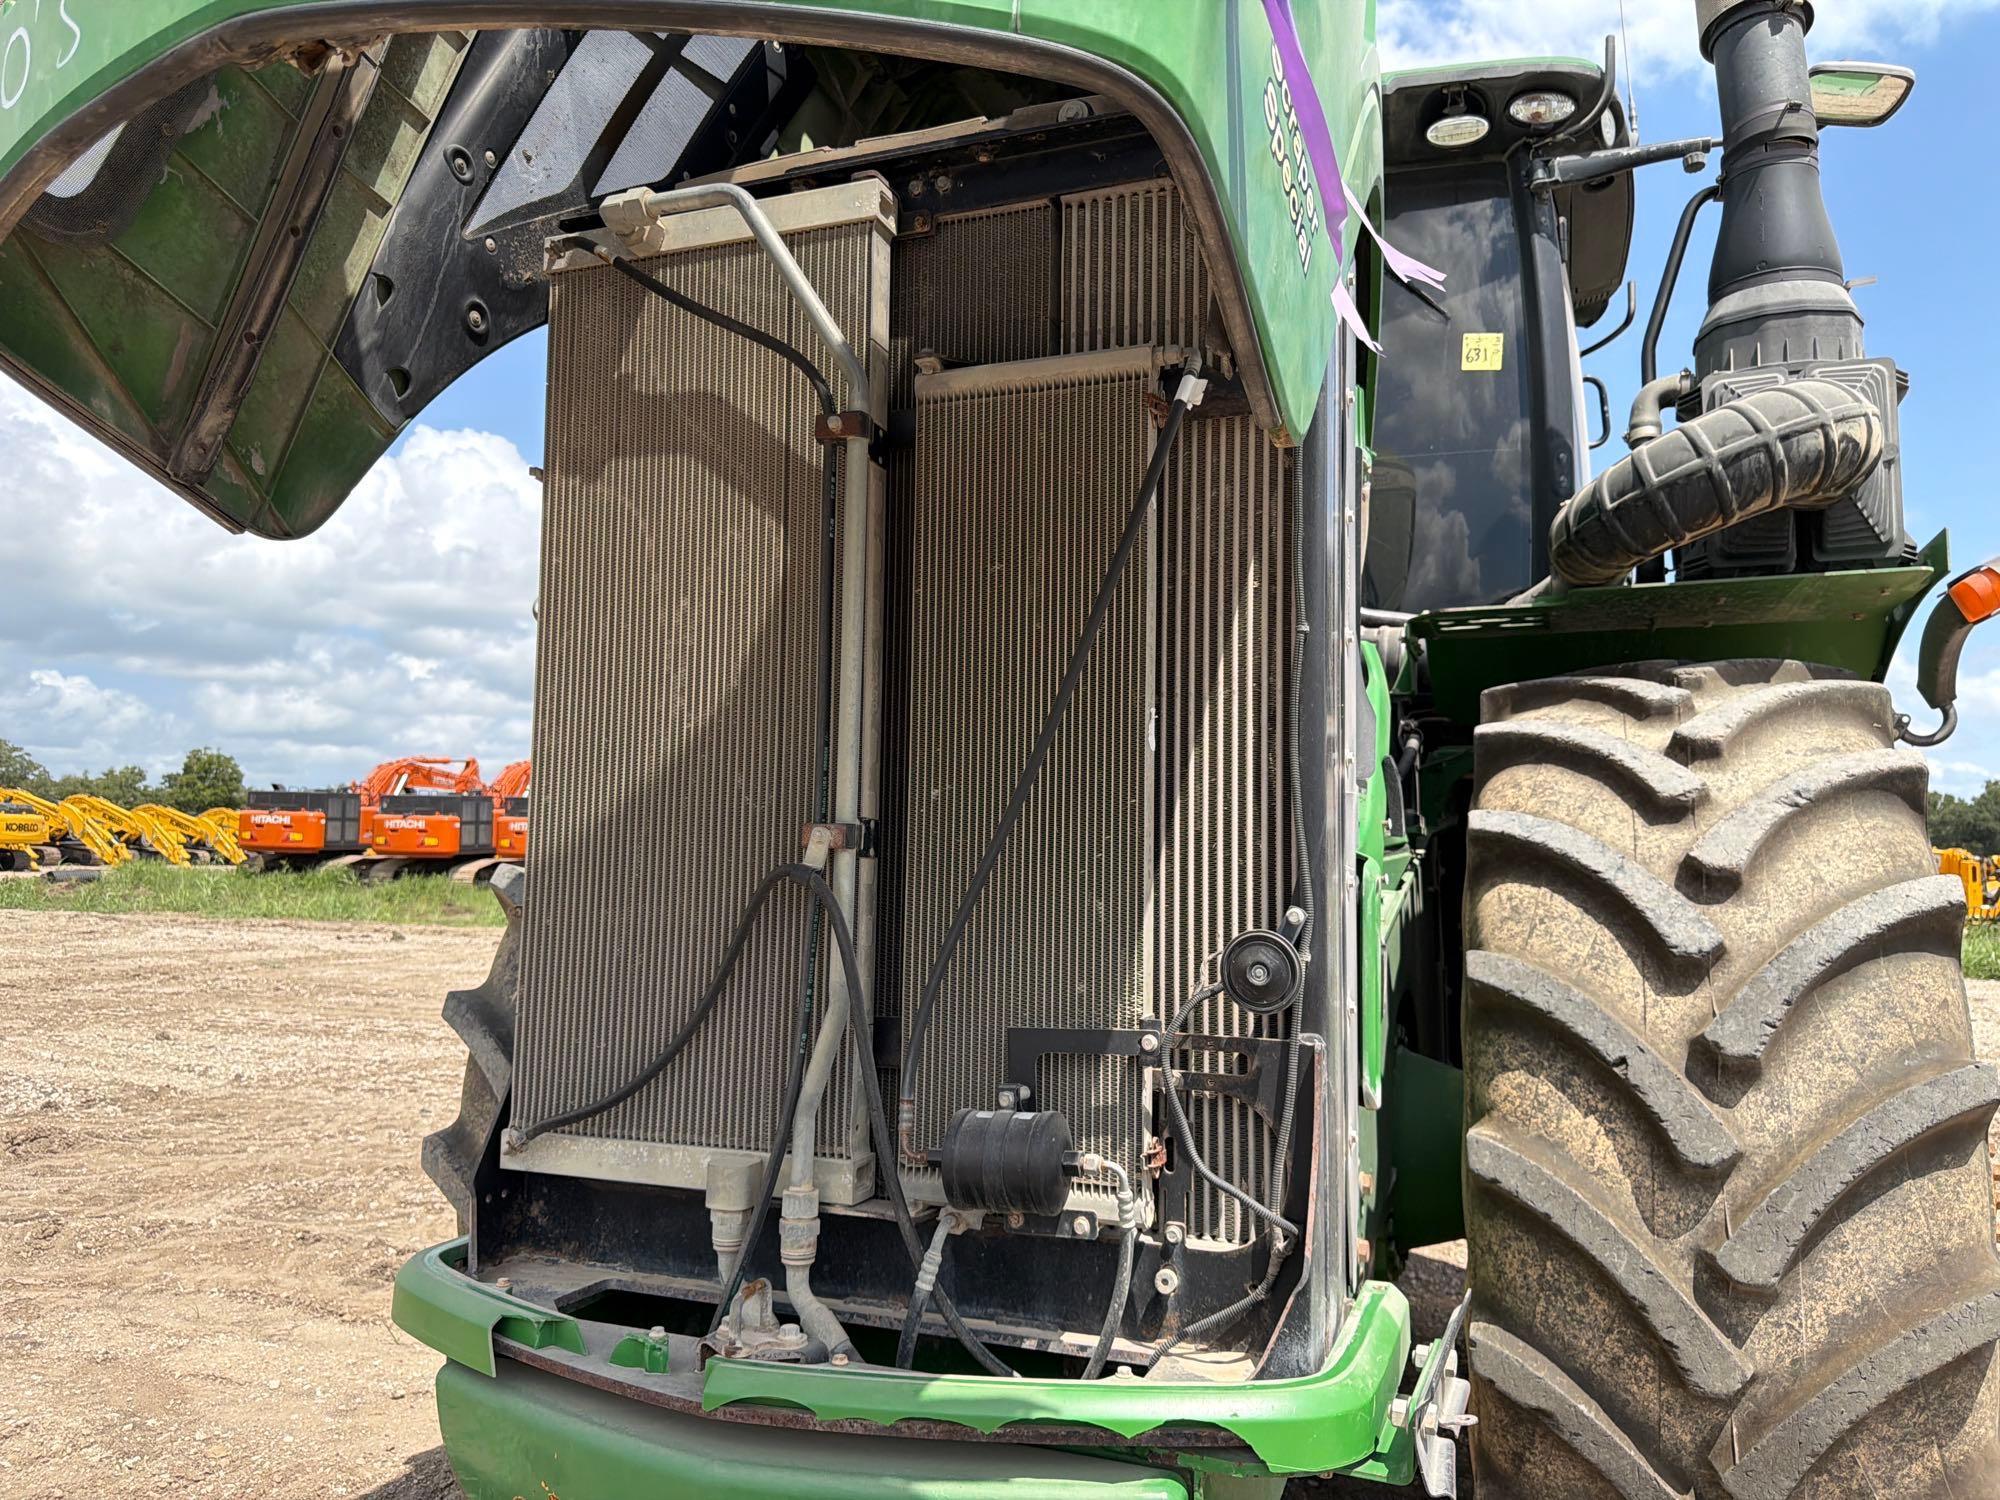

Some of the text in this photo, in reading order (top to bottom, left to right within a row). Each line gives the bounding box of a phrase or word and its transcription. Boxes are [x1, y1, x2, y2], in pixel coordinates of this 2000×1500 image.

[1263, 77, 1312, 279] Special
[1465, 347, 1488, 364] 631
[250, 814, 291, 825] HITACHI
[384, 819, 426, 829] HITACHI
[5, 823, 39, 832] KOBELCO
